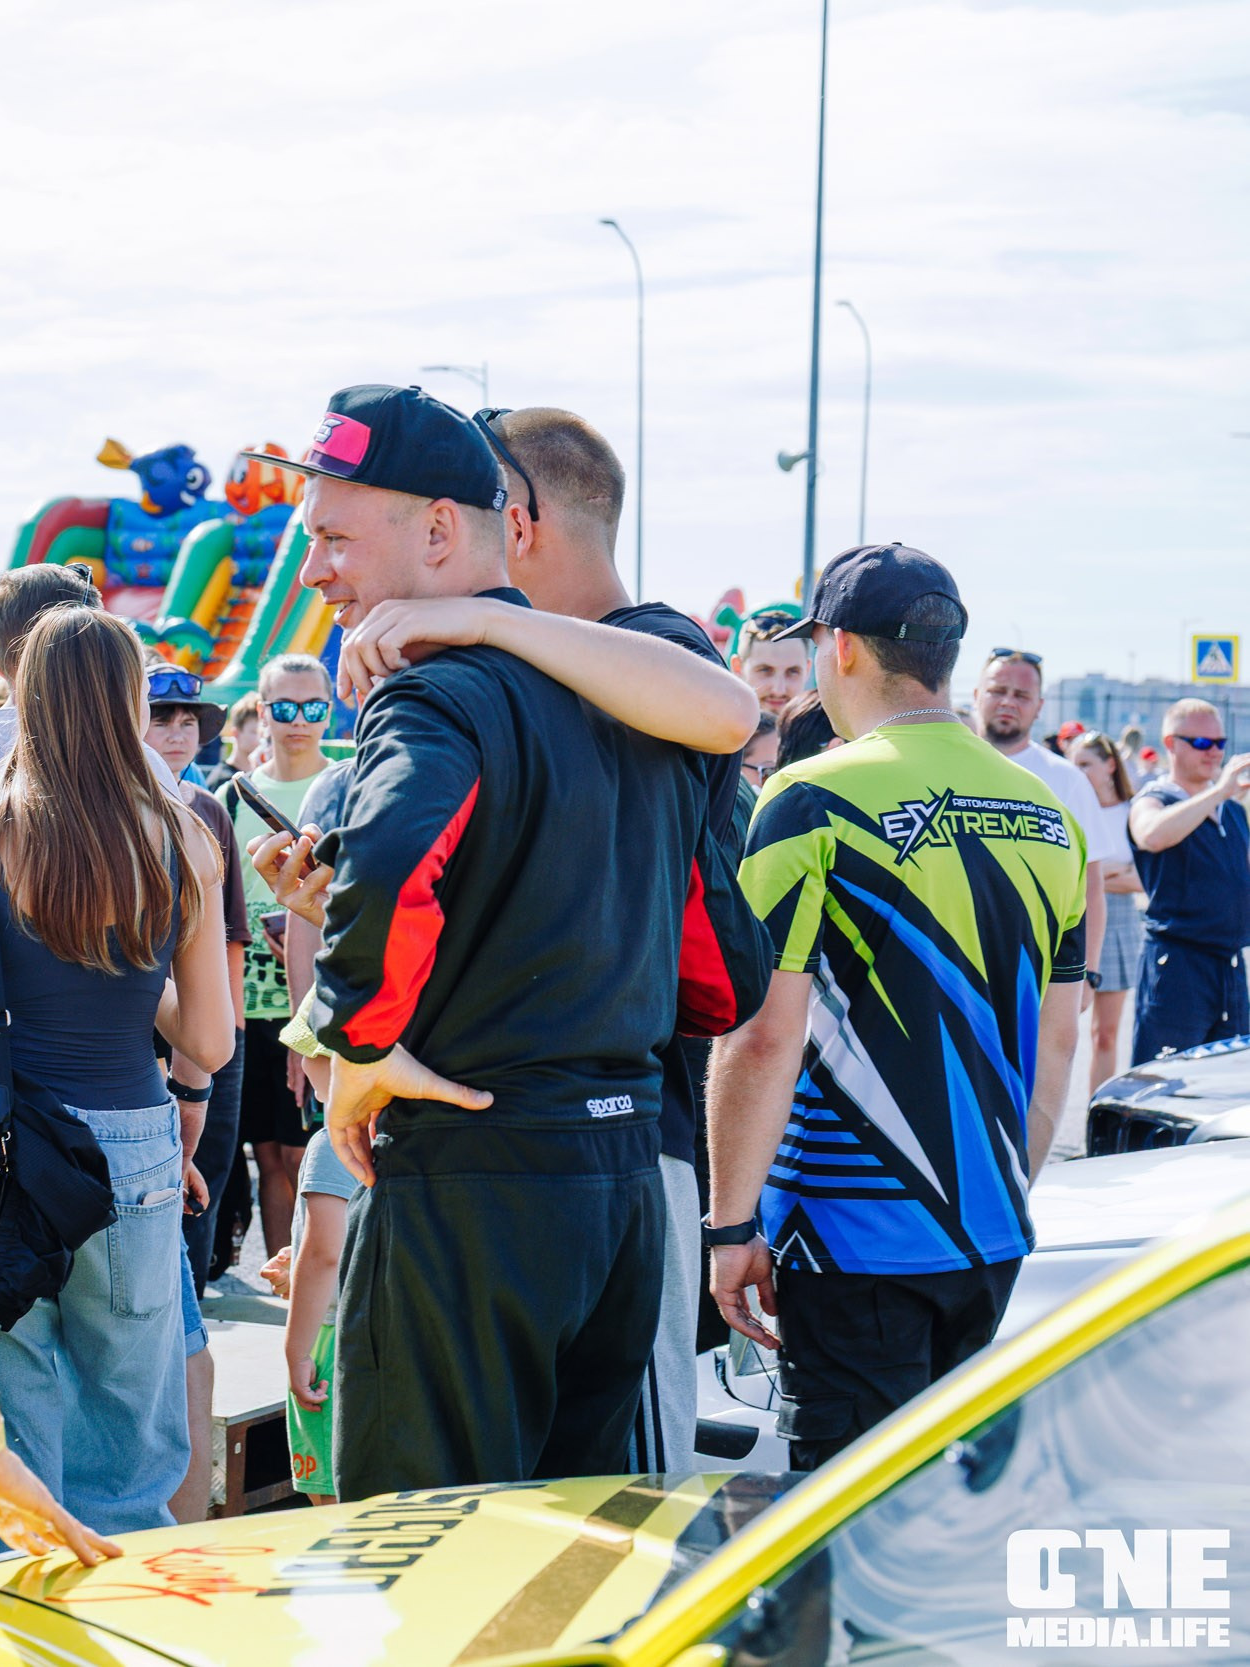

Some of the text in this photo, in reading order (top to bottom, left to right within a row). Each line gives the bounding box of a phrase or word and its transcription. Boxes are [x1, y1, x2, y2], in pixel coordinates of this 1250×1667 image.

[952, 797, 1062, 821] АВТОМОБИЛЬНЫЙ СПОРТ
[882, 793, 1070, 860] EXTREME39
[586, 1094, 634, 1118] sparco
